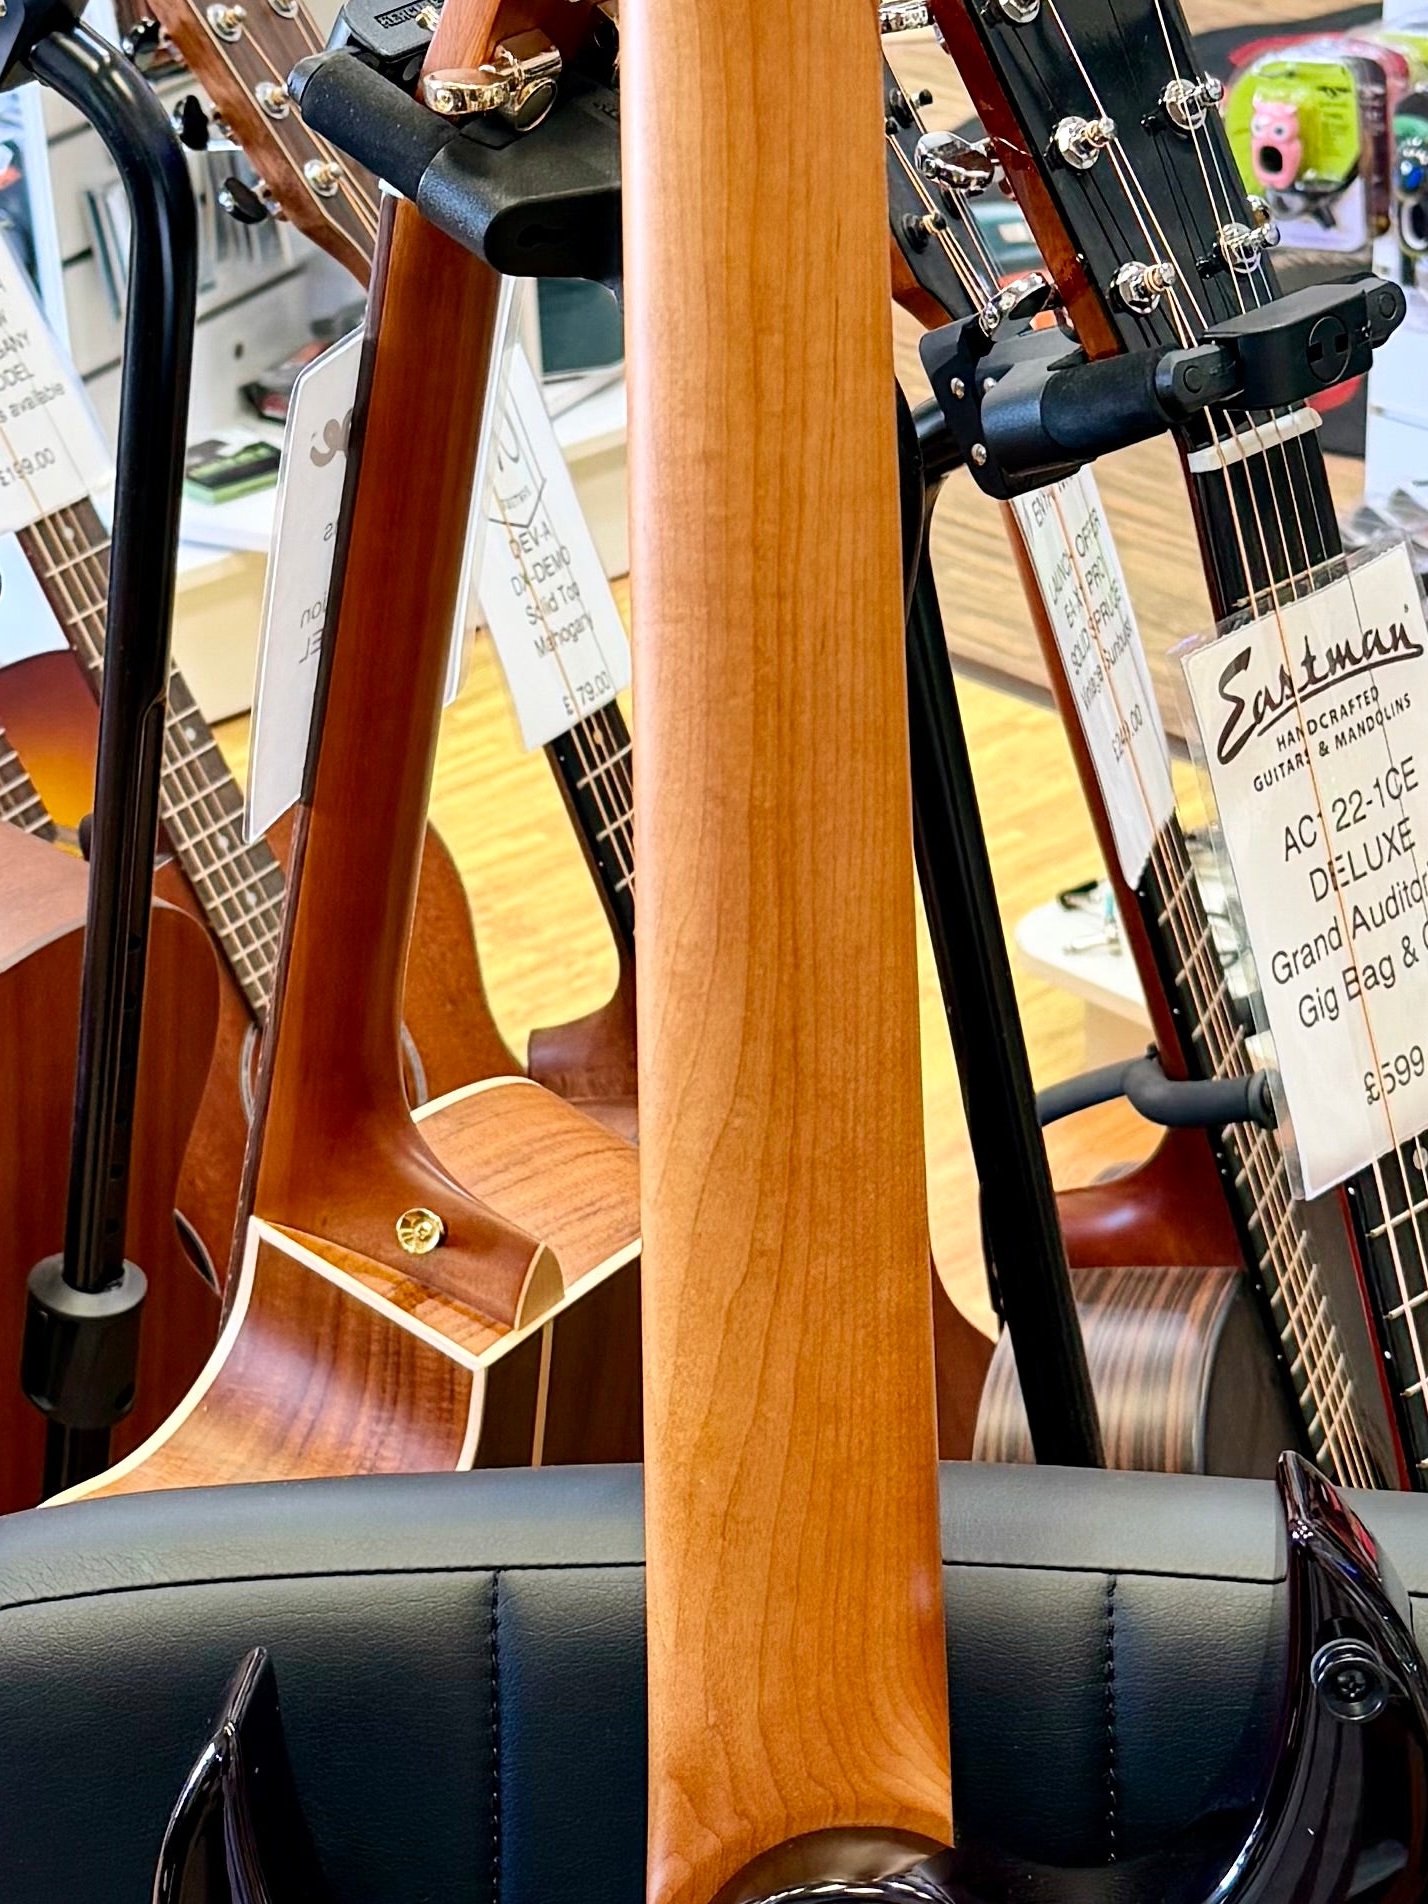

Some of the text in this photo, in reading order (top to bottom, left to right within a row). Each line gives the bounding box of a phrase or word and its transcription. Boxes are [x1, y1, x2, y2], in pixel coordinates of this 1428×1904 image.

[1074, 506, 1101, 558] OFFER
[558, 580, 581, 606] Top
[561, 669, 611, 716] £79.00
[1215, 618, 1425, 767] Eastman
[1275, 686, 1381, 752] HANDCRAFTED
[1252, 692, 1413, 794] GUITARS & MANDOLINS
[1308, 816, 1418, 904] DELUXE
[1271, 918, 1343, 986] Grand
[1298, 977, 1340, 1030] Gig
[1341, 952, 1397, 1005] Bag
[1401, 936, 1420, 966] &
